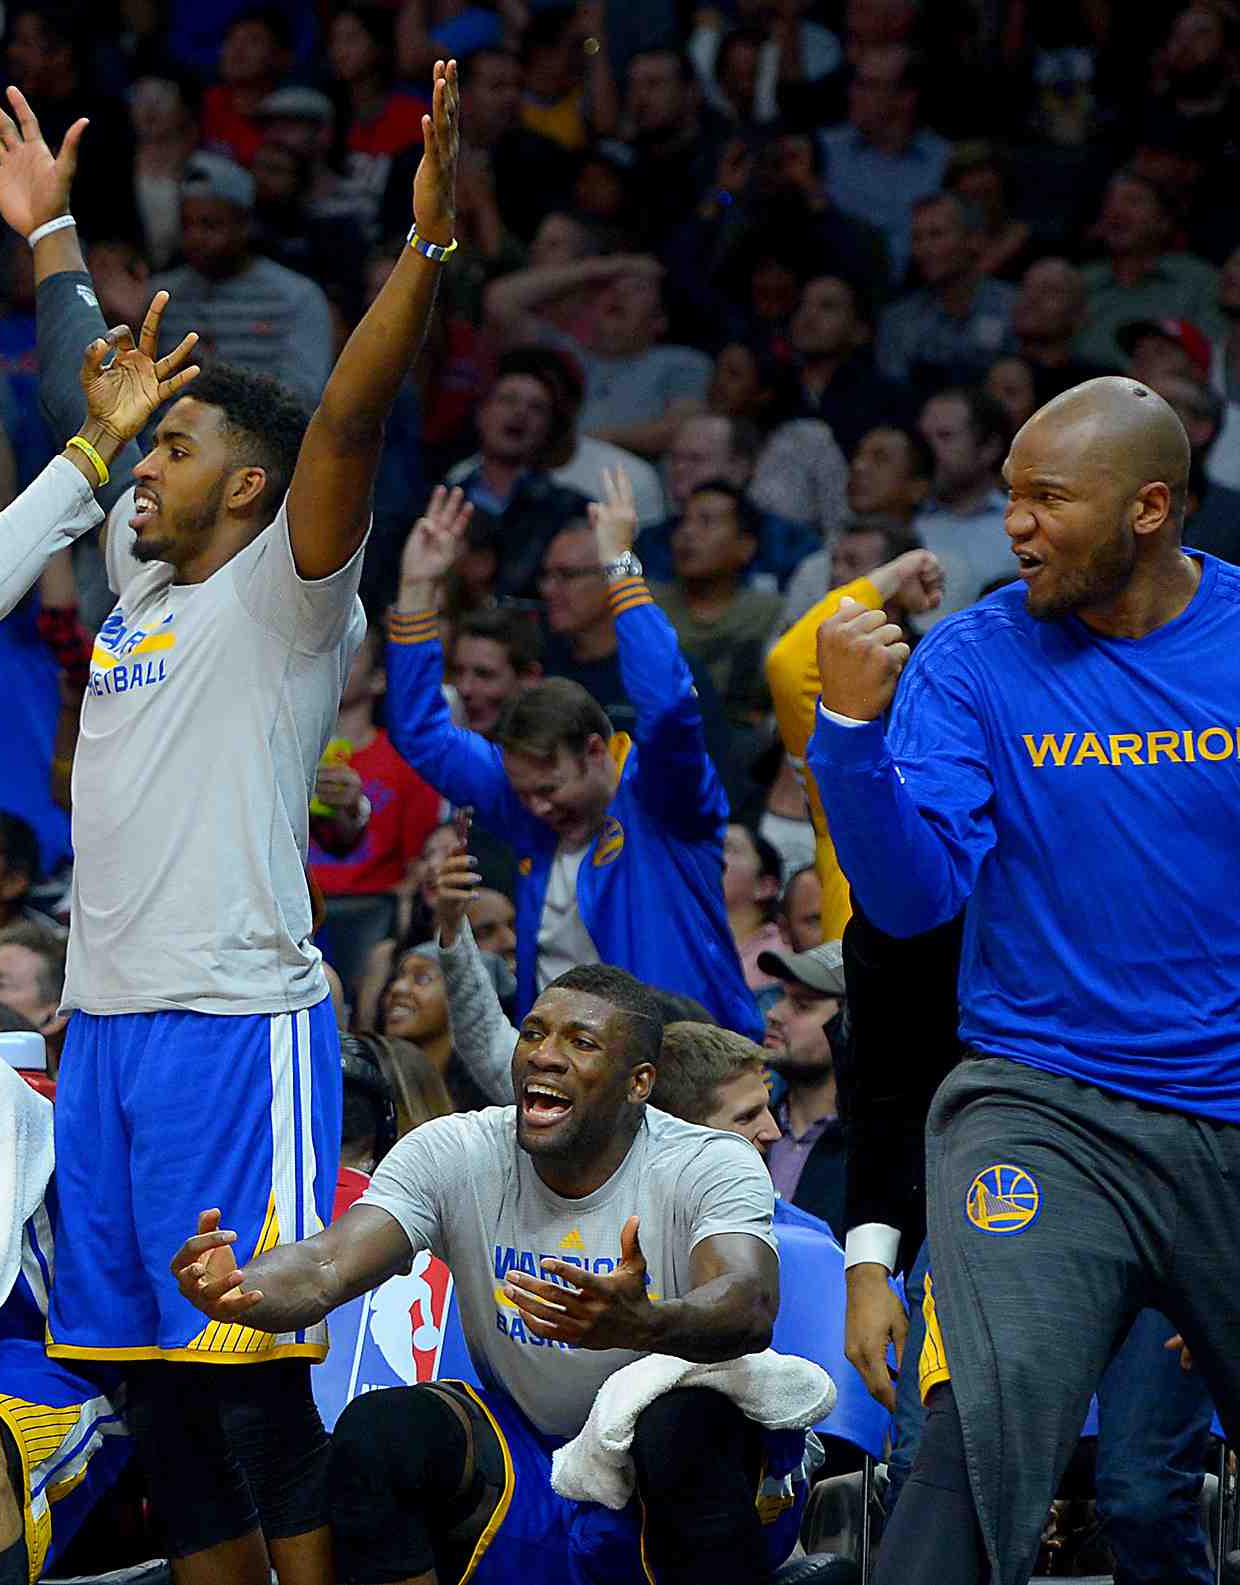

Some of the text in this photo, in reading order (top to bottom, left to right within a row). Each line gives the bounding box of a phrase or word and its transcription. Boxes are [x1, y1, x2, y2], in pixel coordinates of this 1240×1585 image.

[88, 657, 167, 696] ETBALL
[1021, 727, 1240, 767] WARRIO
[494, 1245, 653, 1290] WARRIO
